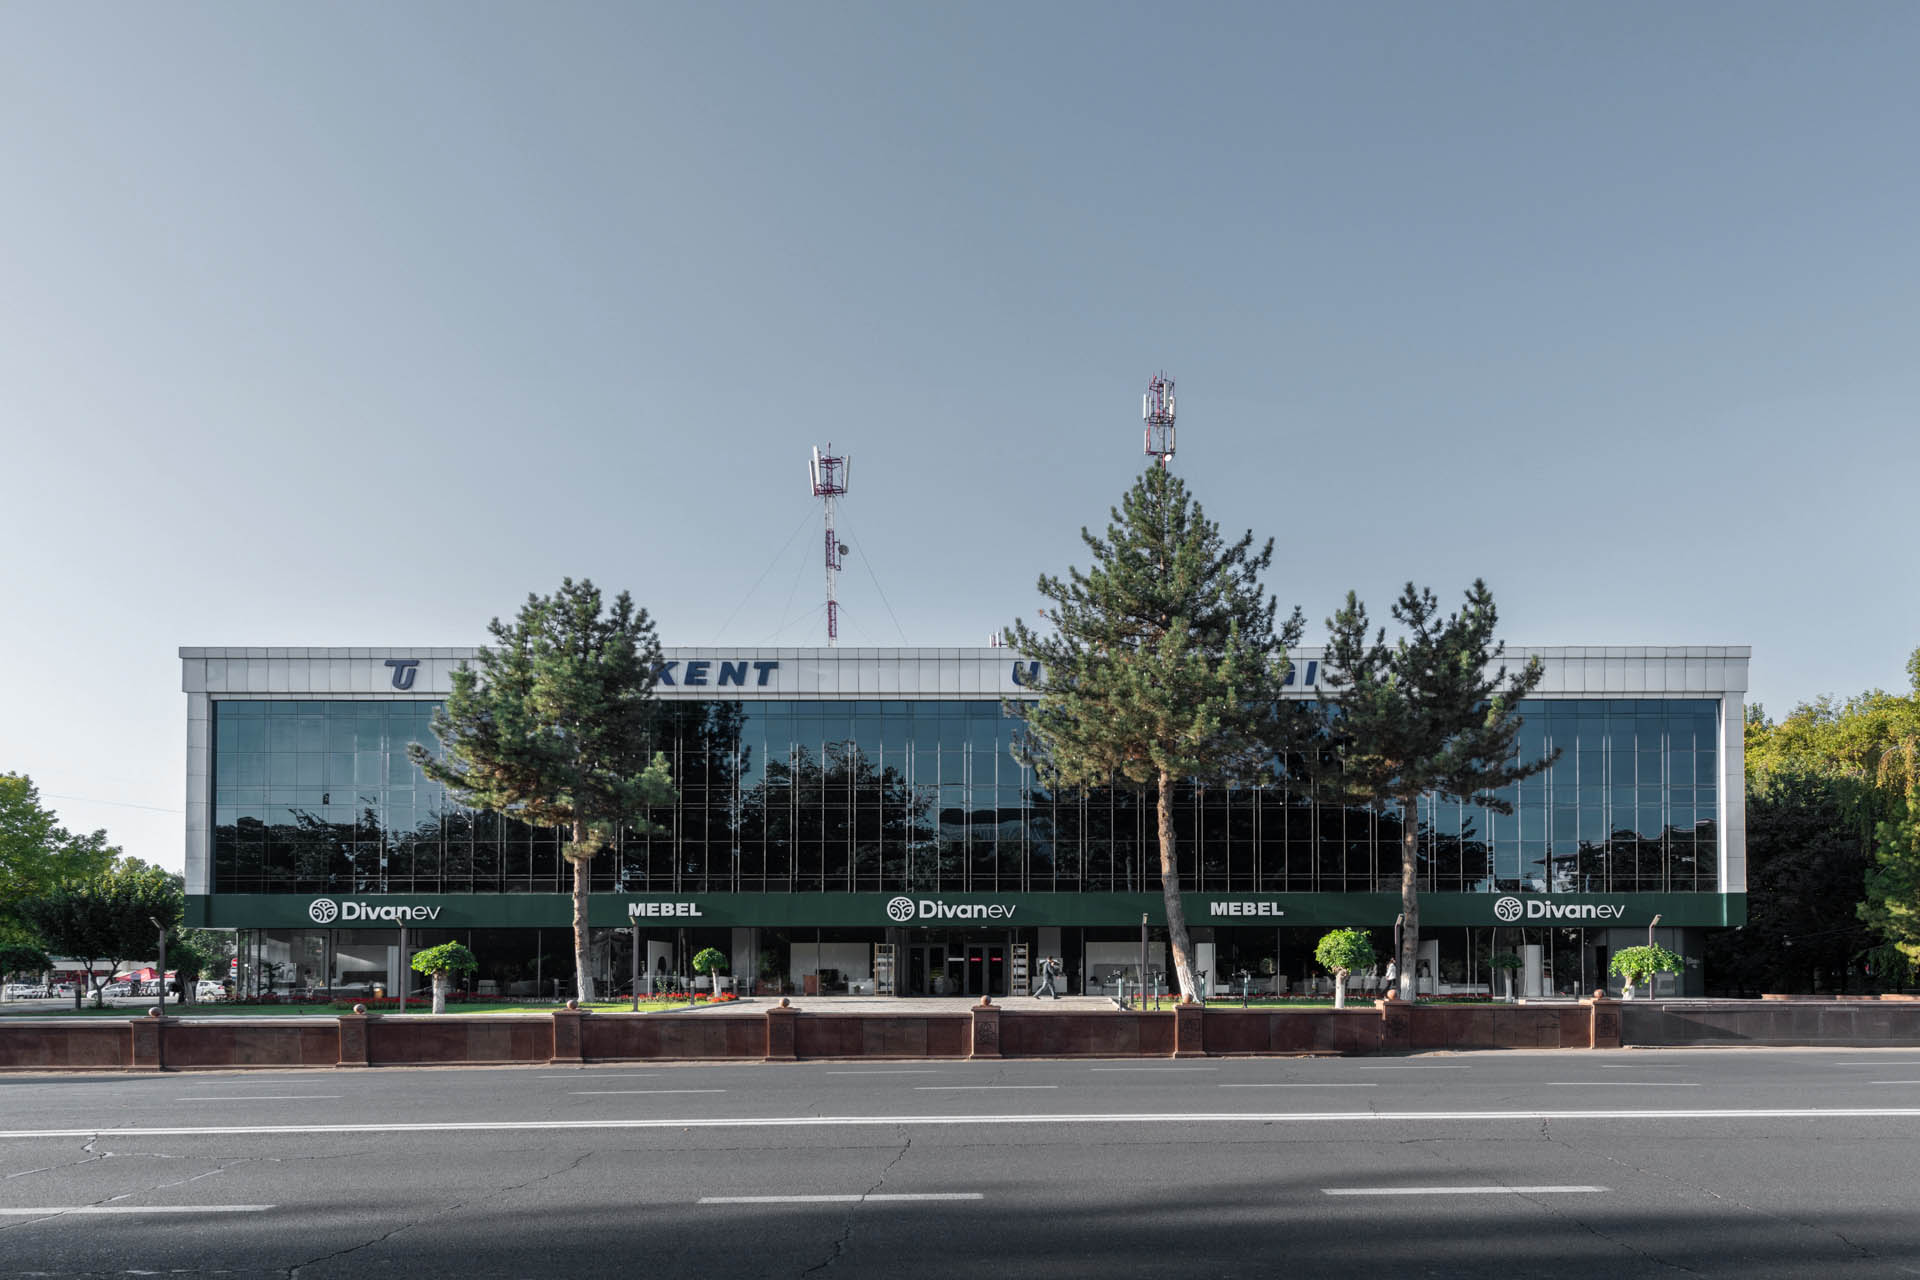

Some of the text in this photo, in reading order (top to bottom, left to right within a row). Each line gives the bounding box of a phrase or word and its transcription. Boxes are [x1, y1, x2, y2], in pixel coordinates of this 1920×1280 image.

[649, 660, 780, 686] KENT
[341, 901, 441, 921] Divanev
[628, 902, 703, 917] MEBEL
[919, 899, 1017, 919] Divanev
[1210, 901, 1285, 916] MEBEL
[1527, 899, 1626, 919] Divanev
